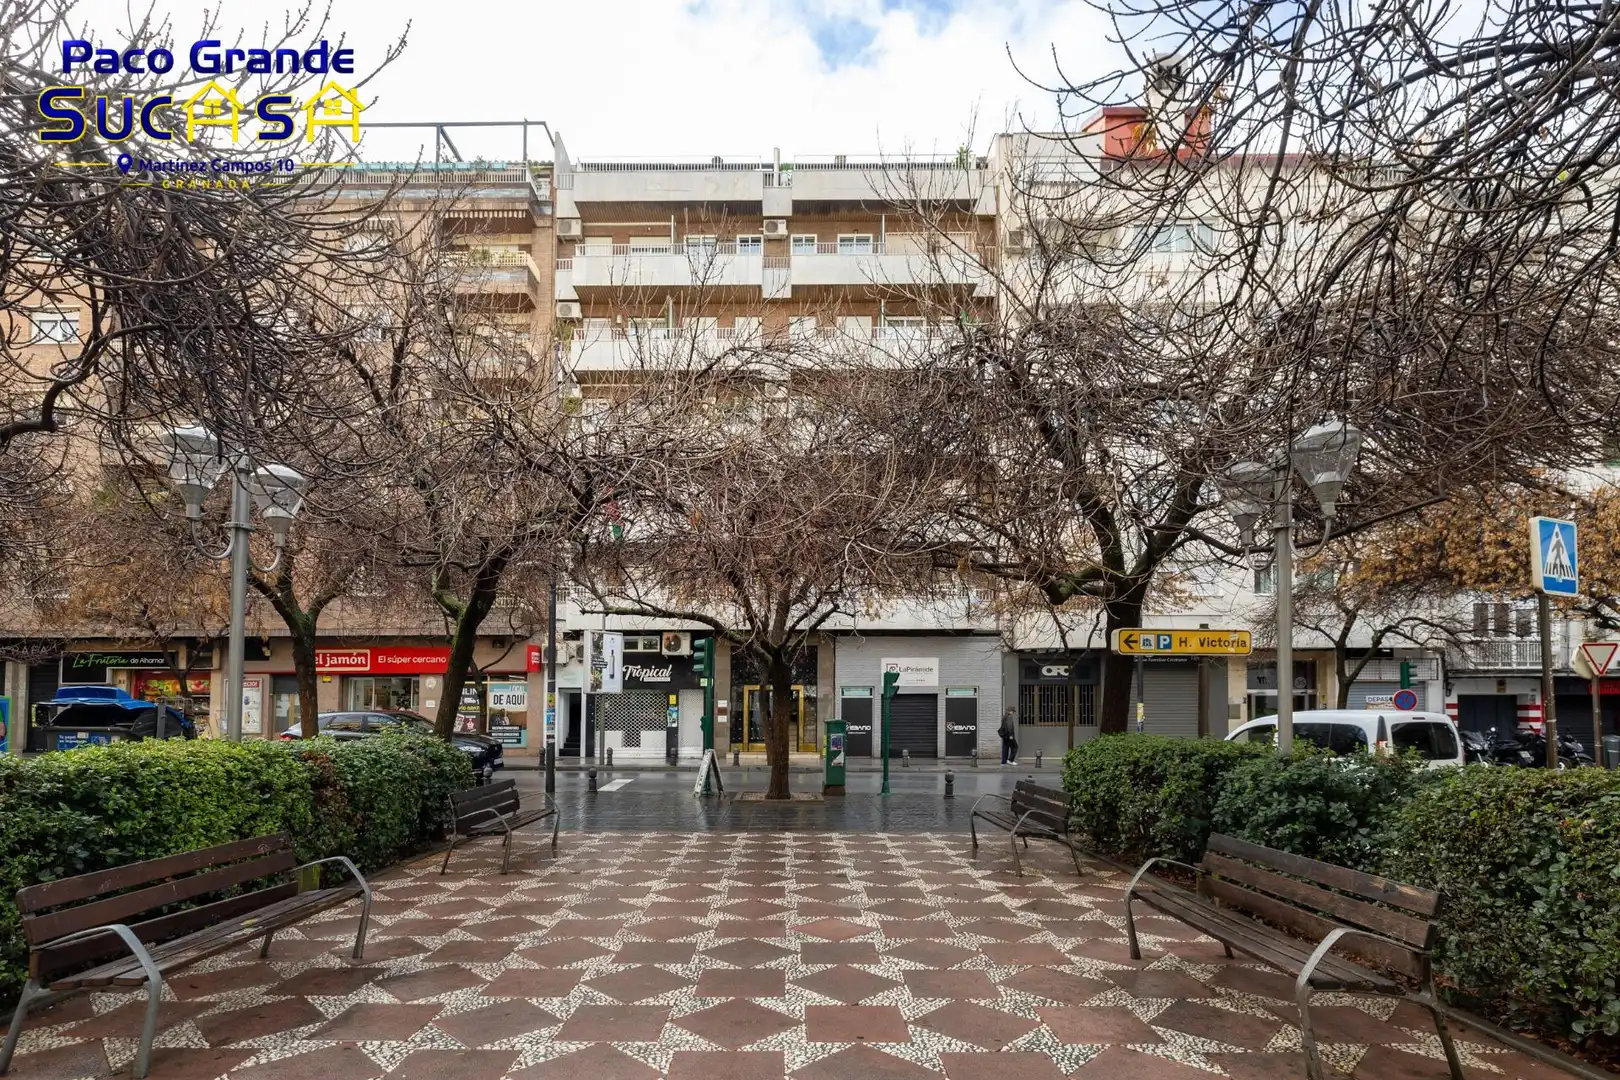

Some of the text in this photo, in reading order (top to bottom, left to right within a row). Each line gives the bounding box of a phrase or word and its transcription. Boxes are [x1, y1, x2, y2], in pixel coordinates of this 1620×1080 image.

[1178, 636, 1193, 648] H.
[1199, 636, 1247, 648] Victoria
[325, 652, 366, 667] jamón
[378, 654, 447, 667] El súper cercano
[622, 664, 673, 682] Tropical
[493, 693, 525, 706] DE AQUÍ
